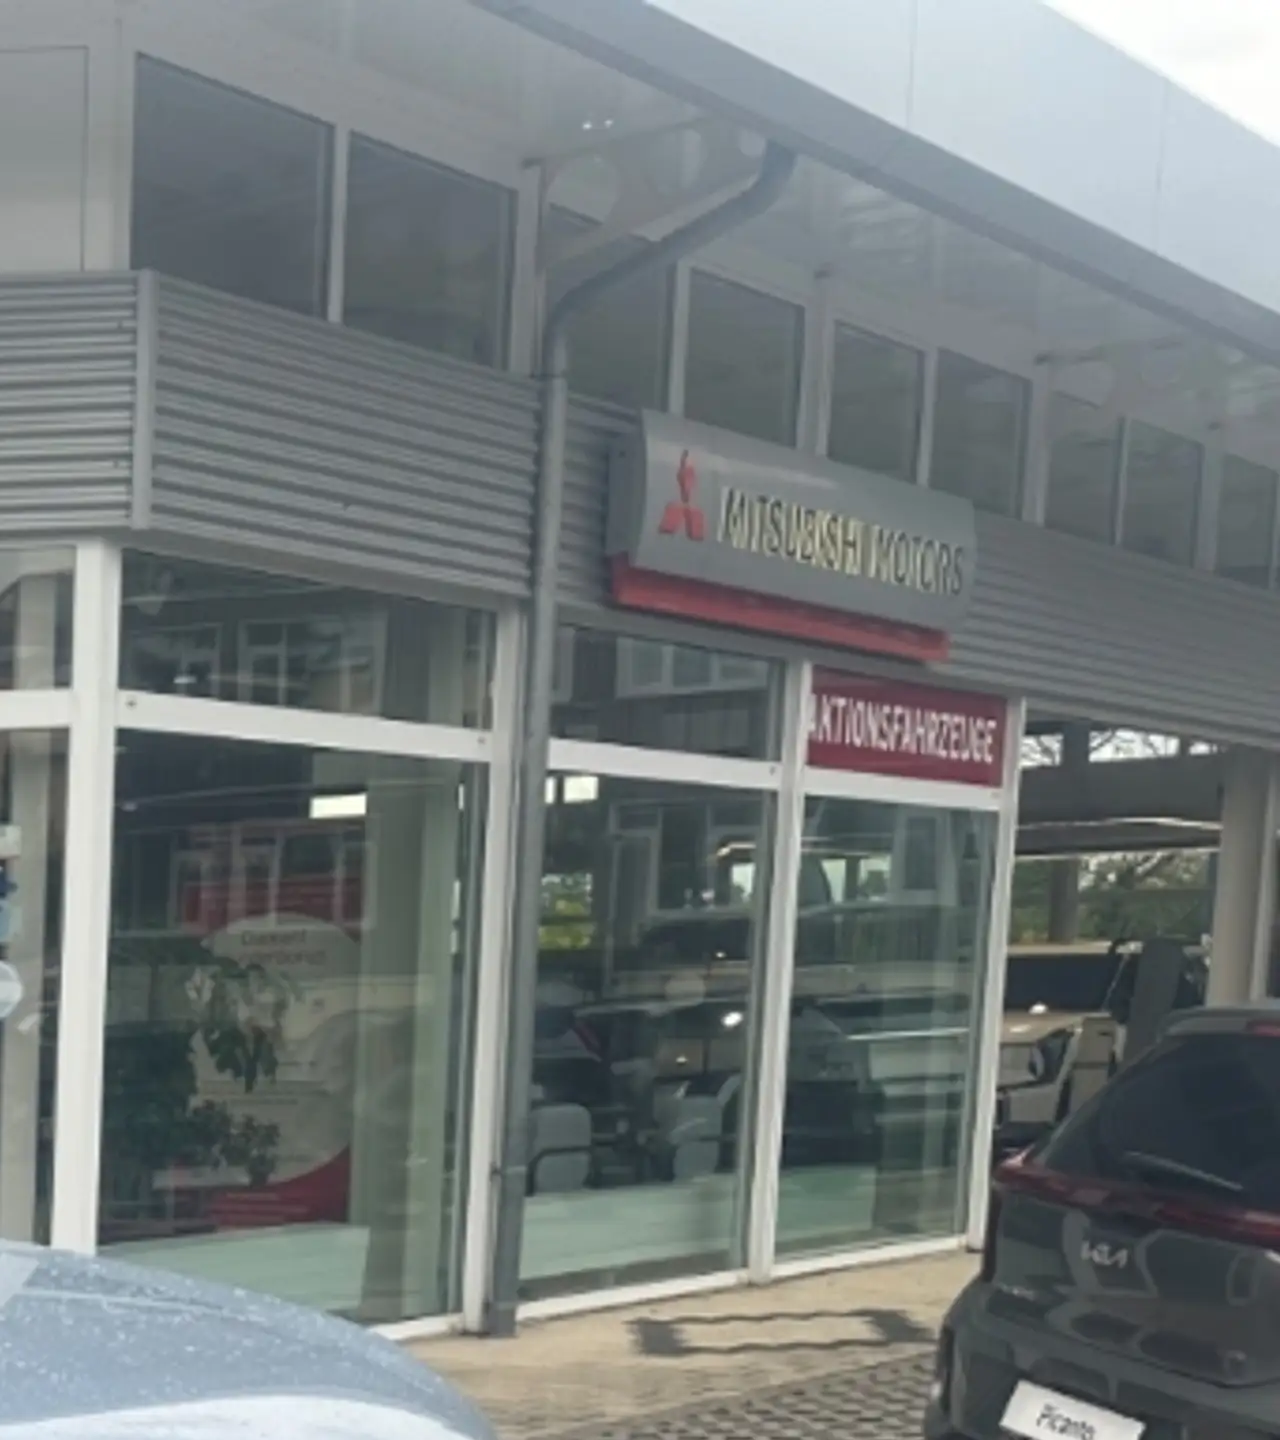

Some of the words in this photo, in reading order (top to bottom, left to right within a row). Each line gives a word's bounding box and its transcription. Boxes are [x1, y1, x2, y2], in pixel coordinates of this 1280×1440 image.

[717, 485, 863, 576] MITSUBISHI
[868, 523, 964, 596] MOTORS
[1080, 1241, 1129, 1270] KIA
